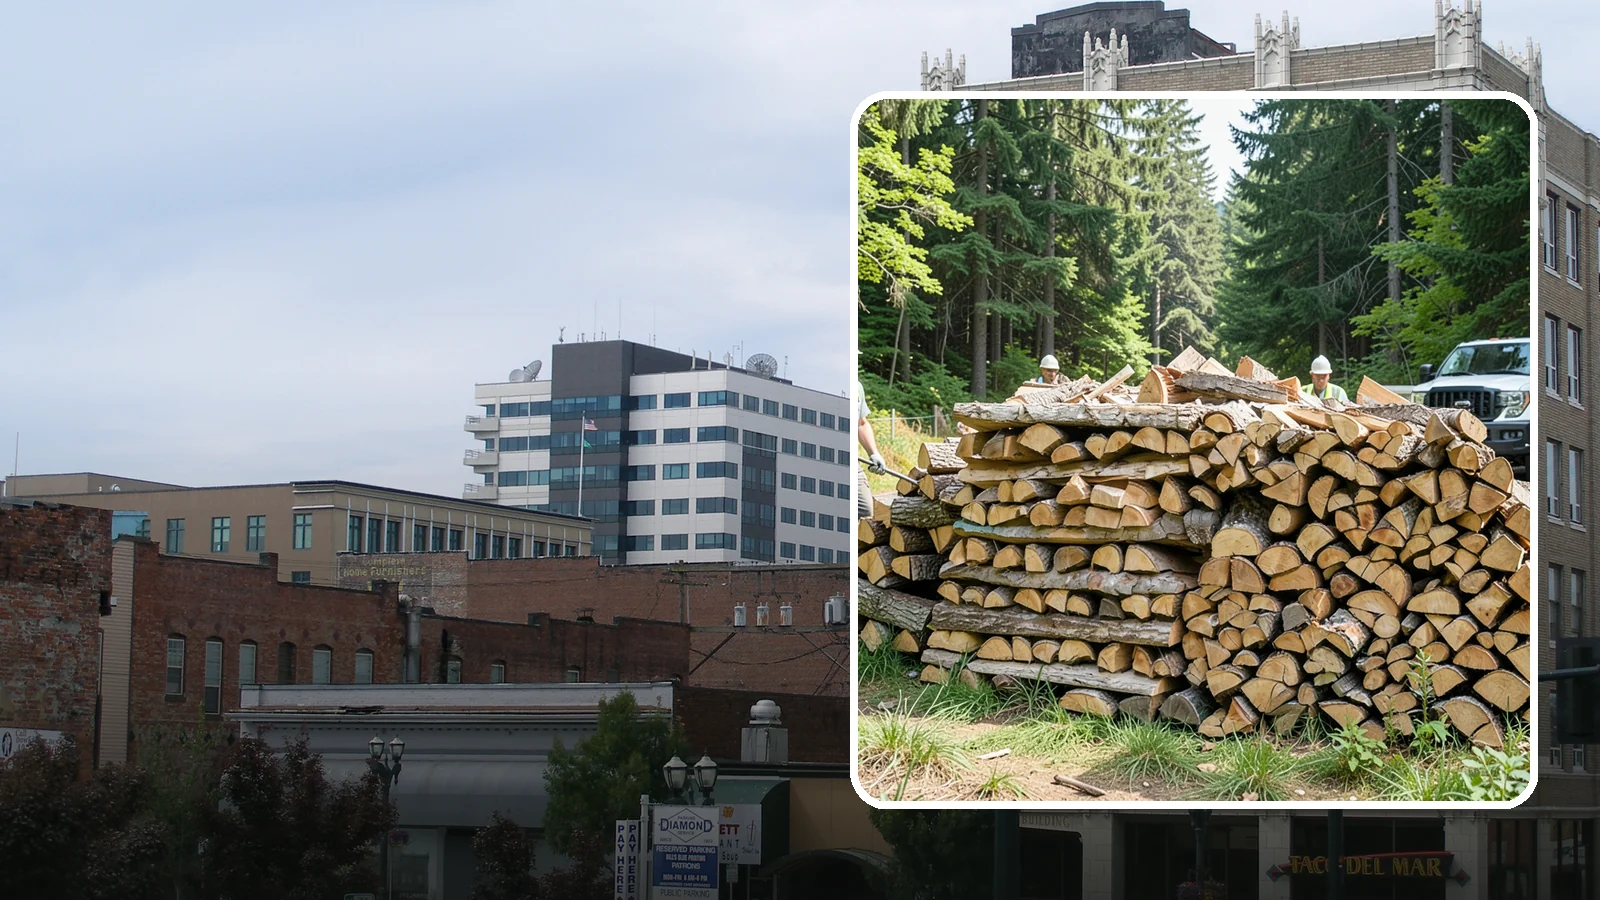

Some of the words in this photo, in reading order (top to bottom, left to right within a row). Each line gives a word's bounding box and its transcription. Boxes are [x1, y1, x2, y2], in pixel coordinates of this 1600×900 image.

[370, 566, 427, 577] Furnishers
[660, 818, 713, 833] DIAMOND
[1022, 815, 1070, 828] BUILDING
[617, 825, 625, 852] PAY
[628, 824, 637, 852] PAY
[656, 845, 688, 853] RESERVED
[689, 846, 716, 854] PARKING
[721, 851, 739, 863] Soup
[671, 862, 701, 870] PATRONS
[1346, 856, 1385, 876] DEL
[1392, 857, 1442, 877] MAR
[616, 856, 625, 893] HERE
[627, 855, 636, 893] HERE
[660, 888, 682, 898] PUBLIC
[683, 889, 710, 899] PARKING
